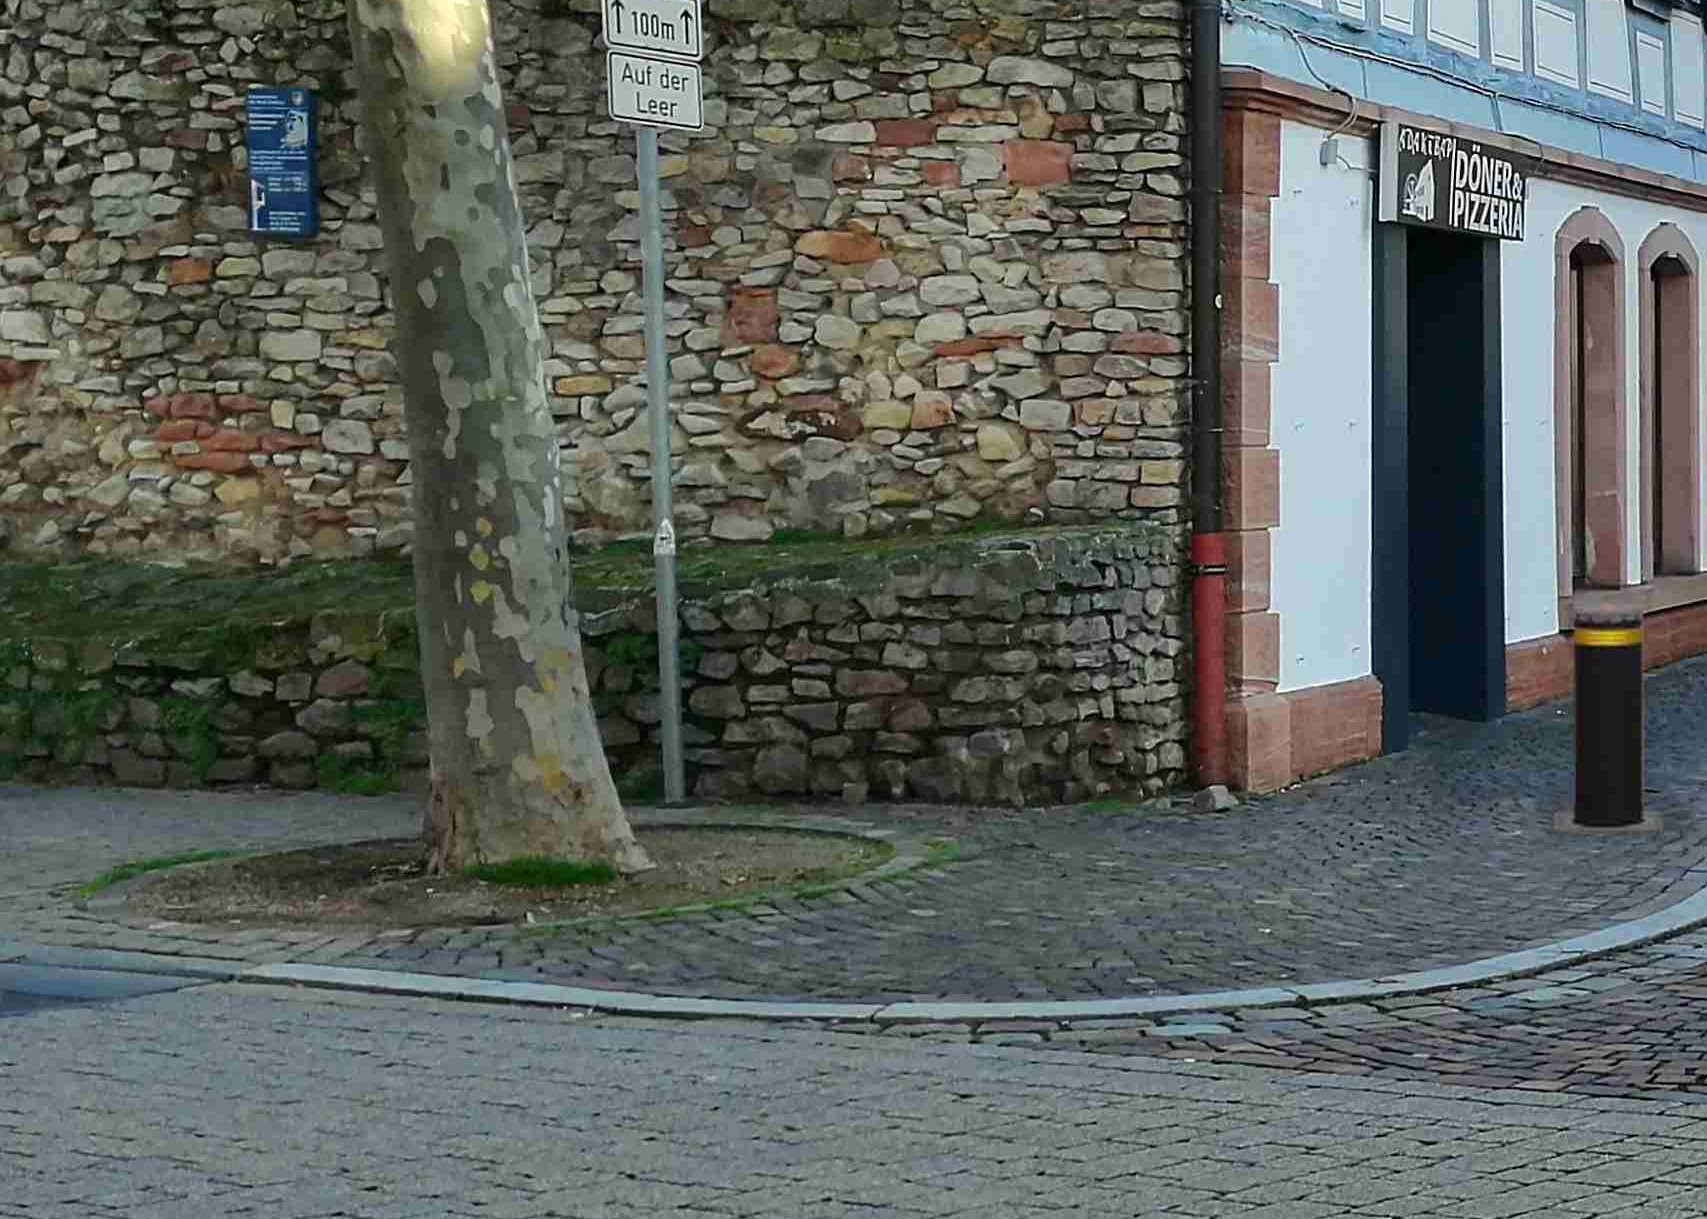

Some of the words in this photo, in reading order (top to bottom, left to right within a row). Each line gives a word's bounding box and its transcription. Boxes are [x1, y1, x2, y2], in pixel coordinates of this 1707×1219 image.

[631, 10, 676, 41] 100m
[621, 62, 653, 87] Auf
[660, 68, 689, 92] der
[635, 91, 678, 118] Leer
[1453, 190, 1523, 240] PIZZERIA
